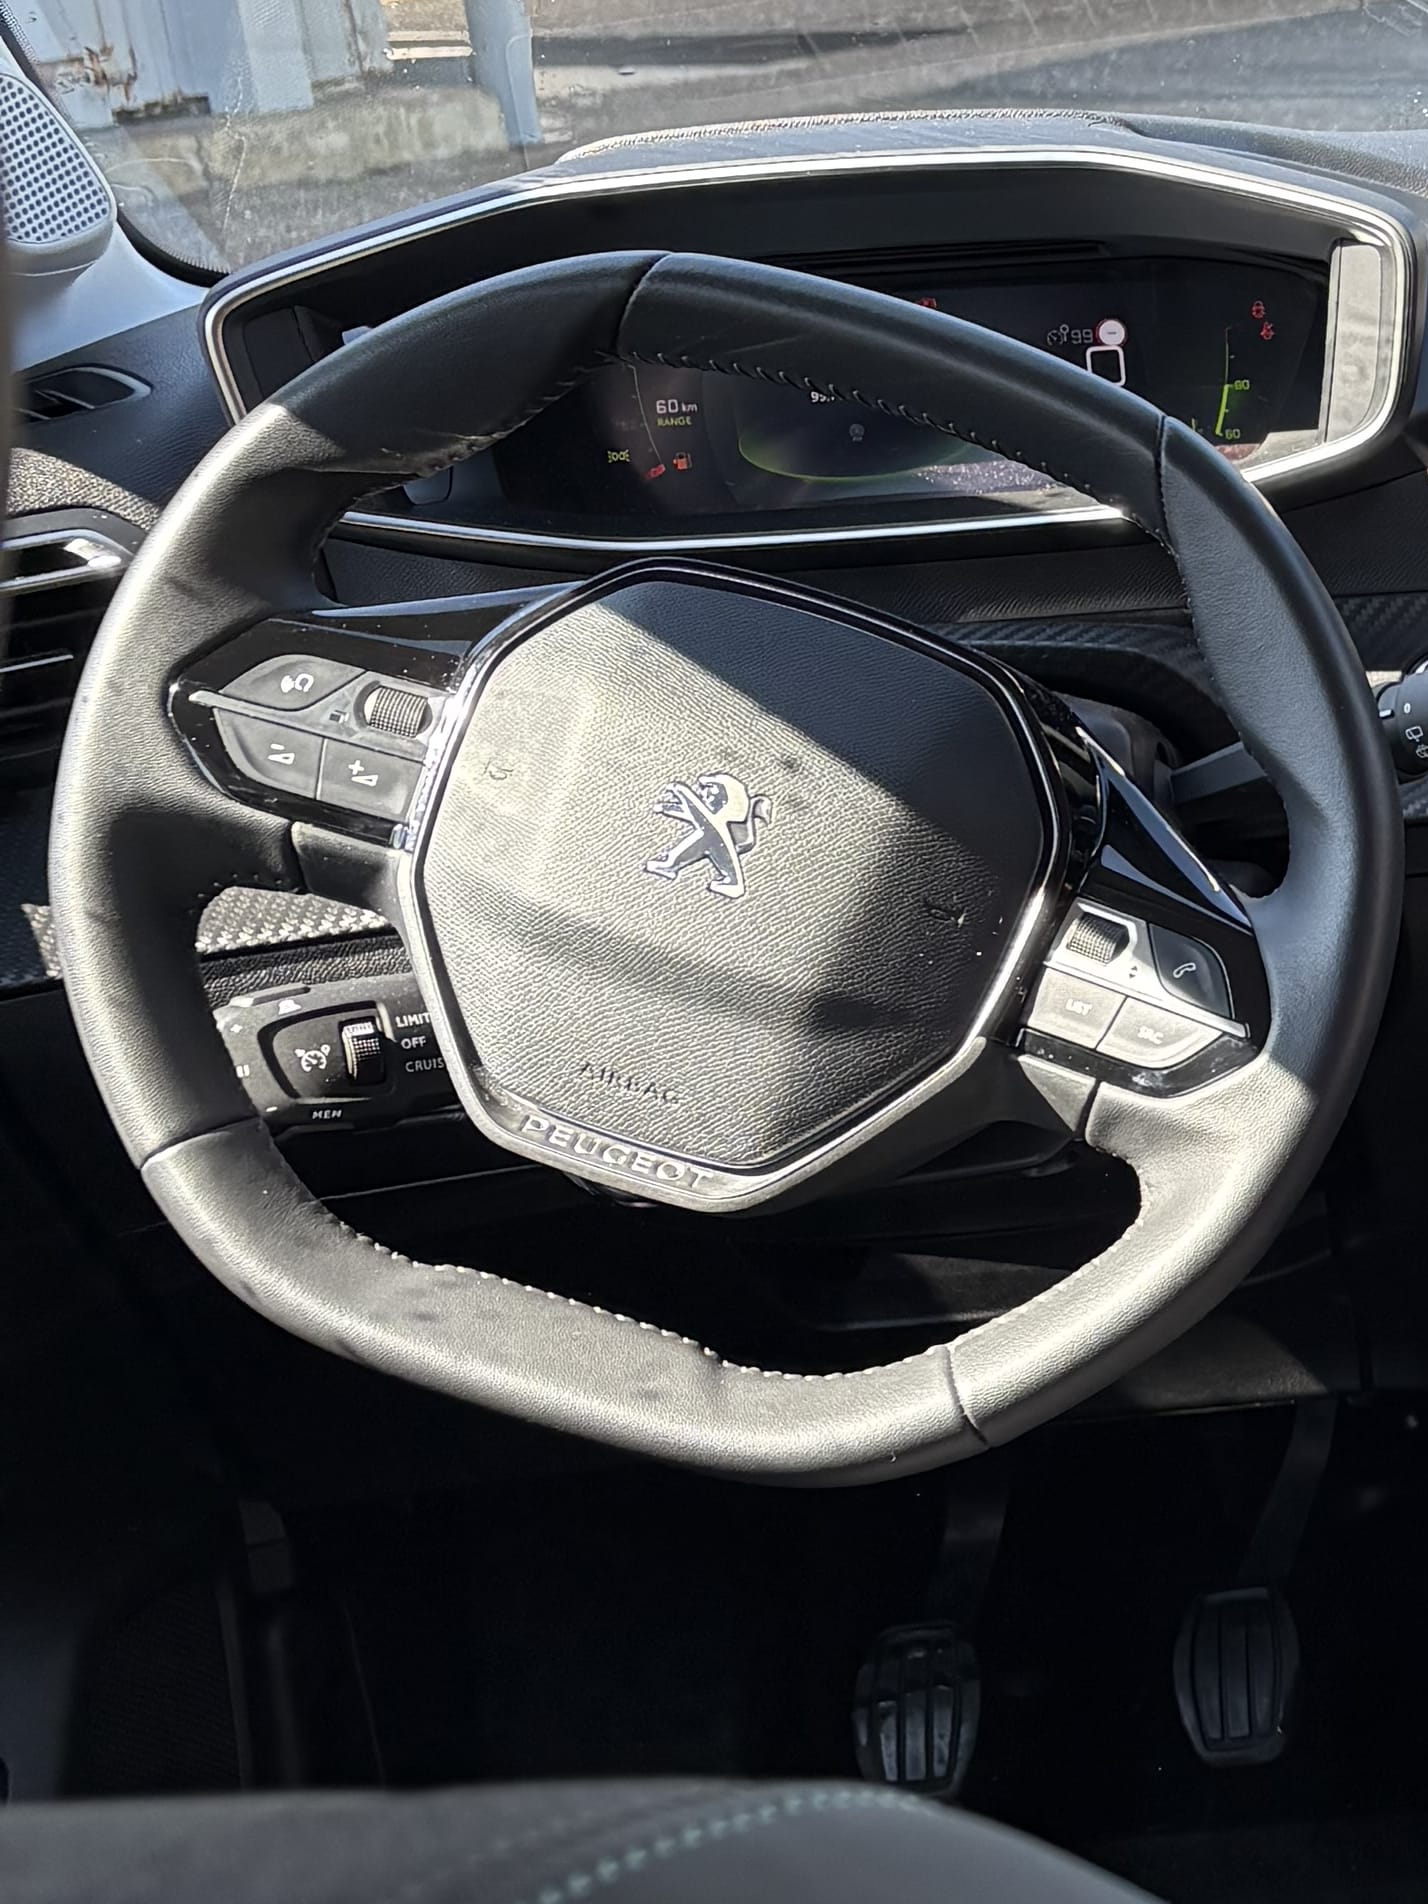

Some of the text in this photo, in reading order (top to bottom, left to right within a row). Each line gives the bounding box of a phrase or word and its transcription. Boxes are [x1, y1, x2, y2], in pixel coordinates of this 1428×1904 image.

[1070, 328, 1094, 344] 99
[655, 399, 698, 415] 60 km
[656, 416, 692, 427] RANGE
[396, 1012, 433, 1028] LIMIT
[400, 1034, 427, 1050] OFF
[405, 1056, 445, 1073] CRUIS
[577, 1061, 681, 1105] AIRBAG
[519, 1113, 715, 1188] PEUGEOT
